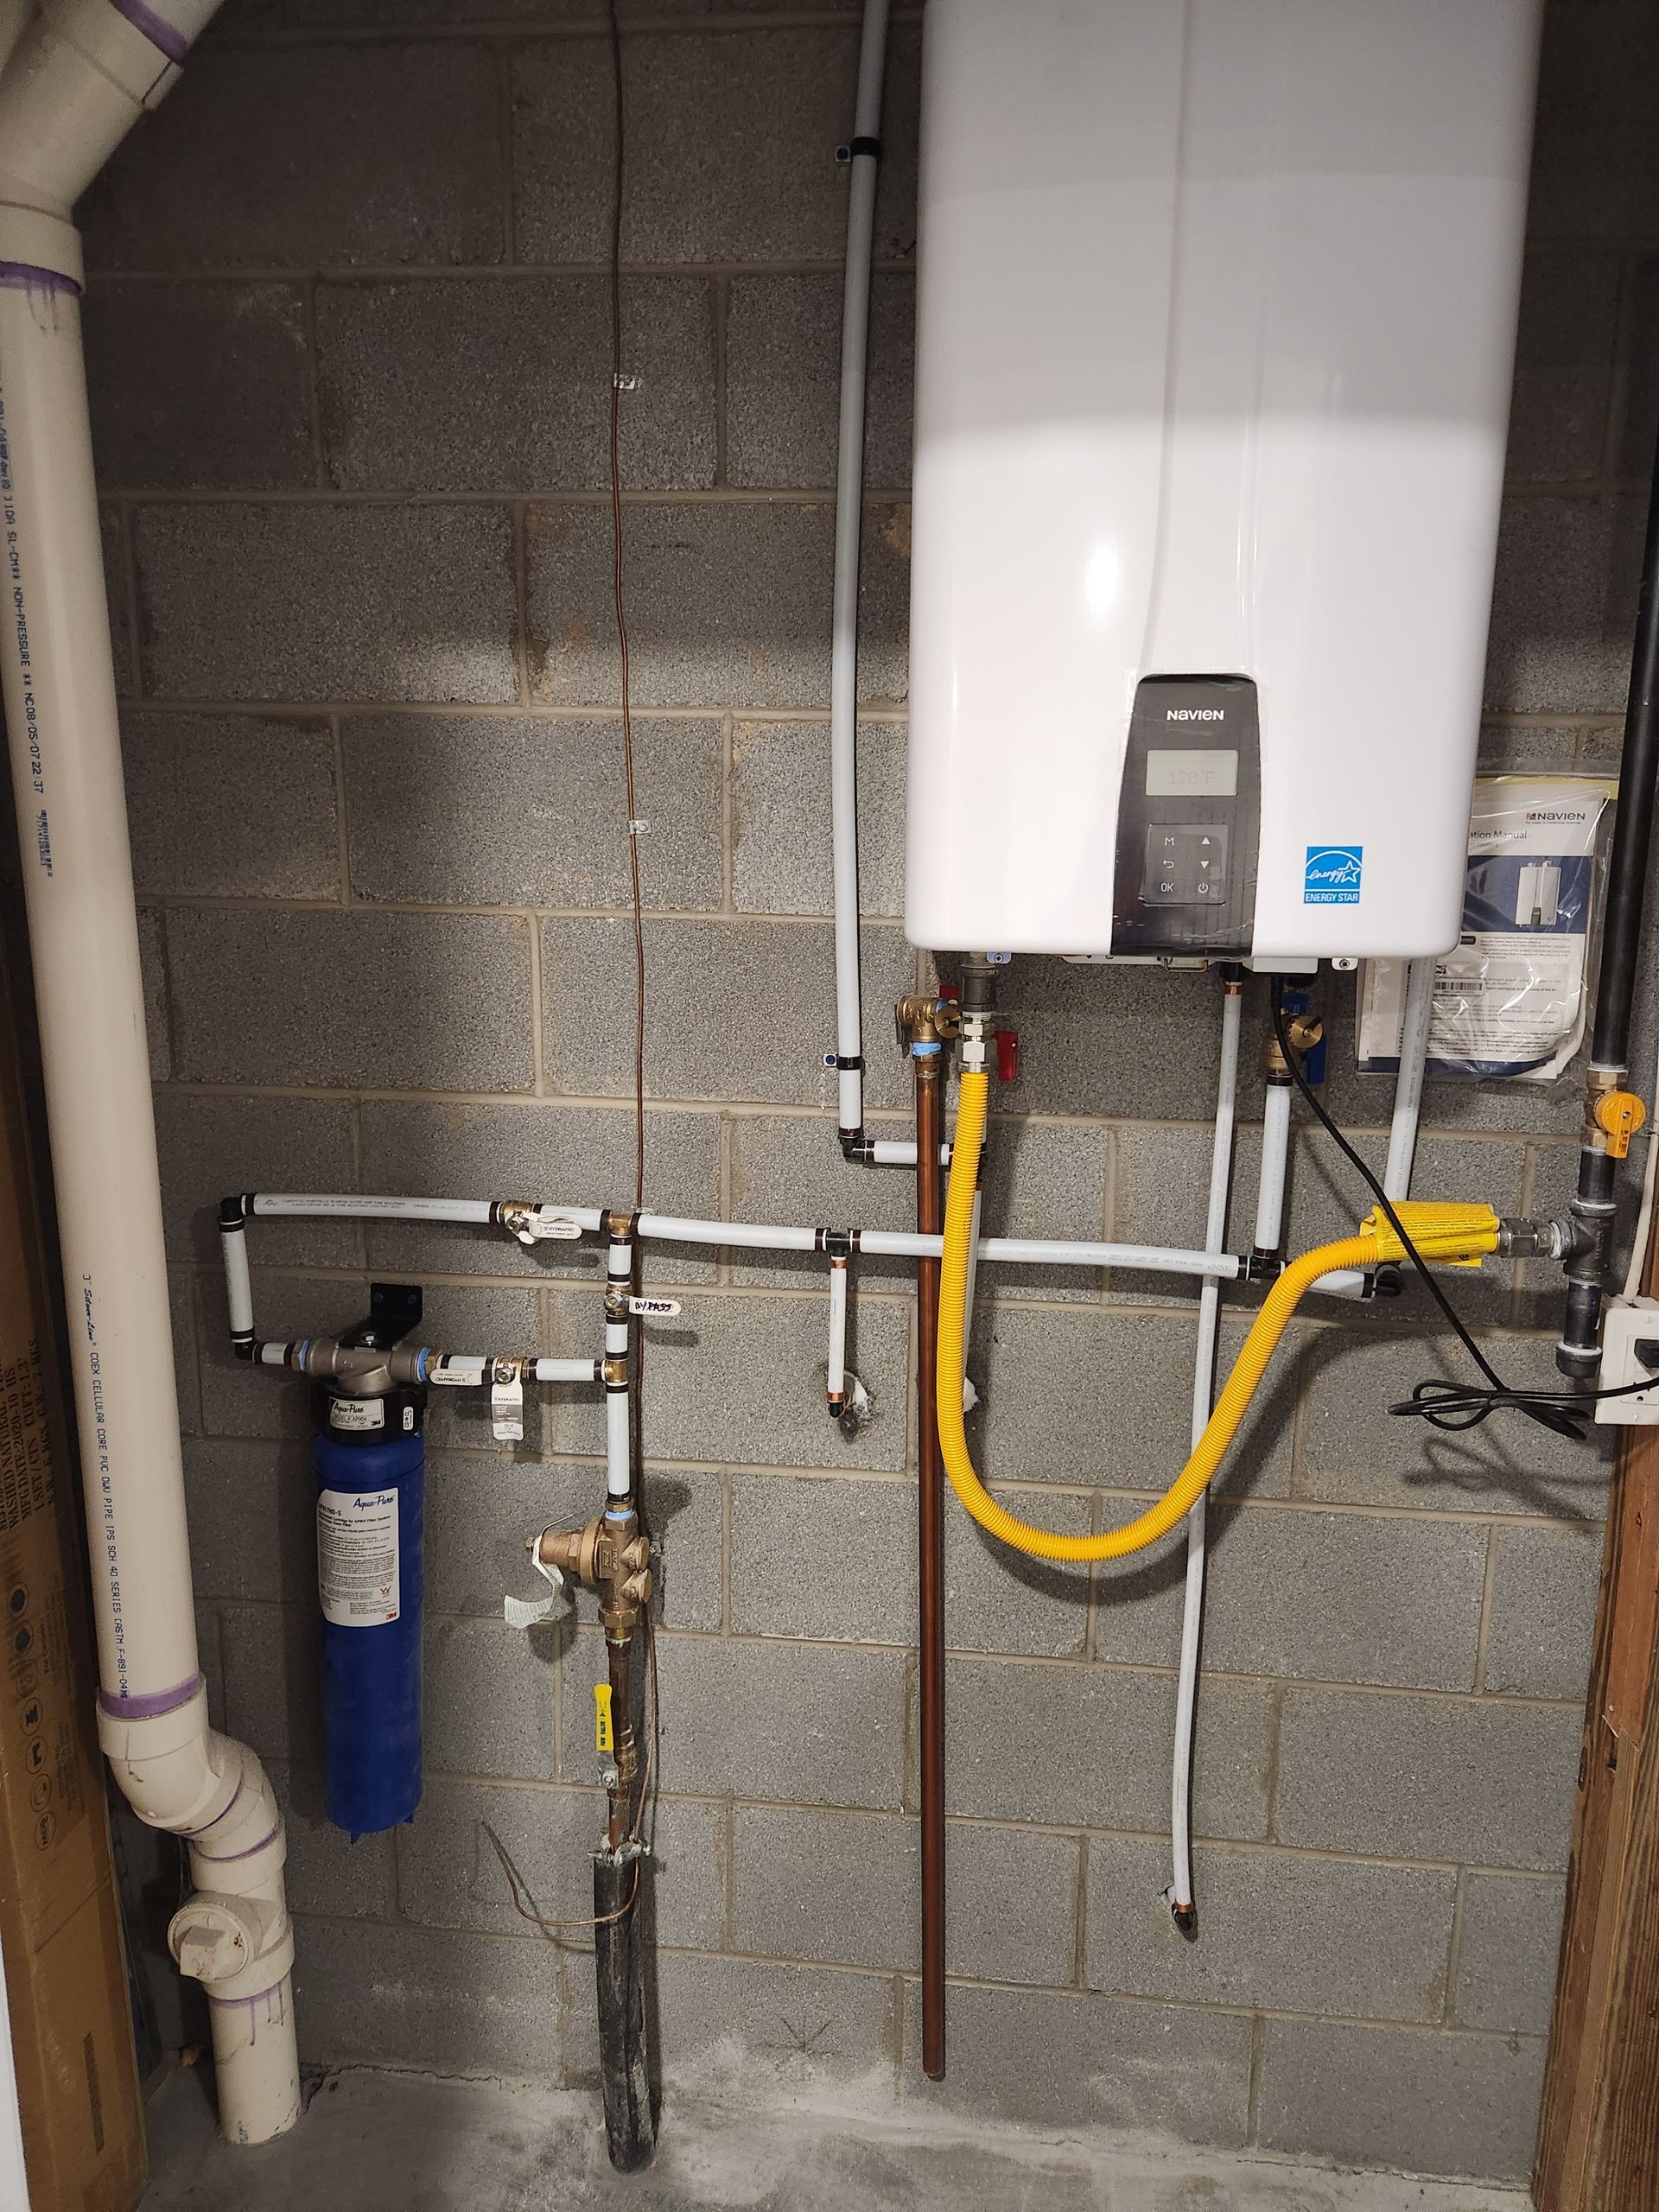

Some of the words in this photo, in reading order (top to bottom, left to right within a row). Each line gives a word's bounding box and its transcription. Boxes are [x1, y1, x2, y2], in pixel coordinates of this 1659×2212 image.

[12, 586, 29, 667] NON-PRESSURE
[1166, 709, 1224, 721] NAVIEN
[1164, 836, 1175, 846] M
[1493, 830, 1528, 839] Manual
[1160, 882, 1174, 892] OK
[1305, 893, 1337, 902] ENERGY
[1338, 893, 1359, 902] STAR
[90, 1351, 99, 1375] COEX
[92, 1379, 104, 1423] CELLULAR
[97, 1428, 106, 1450] CORE
[26, 1437, 39, 1465] CTN
[99, 1455, 108, 1471] PVC
[31, 1476, 43, 1502] SET
[3, 1469, 19, 1529] WASHED
[353, 1495, 395, 1512] Aqua-Pure
[103, 1497, 113, 1519] PIPE
[105, 1524, 114, 1540] IPS
[107, 1544, 116, 1560] SCH
[110, 1566, 118, 1576] 40
[111, 1581, 121, 1612] SERIES
